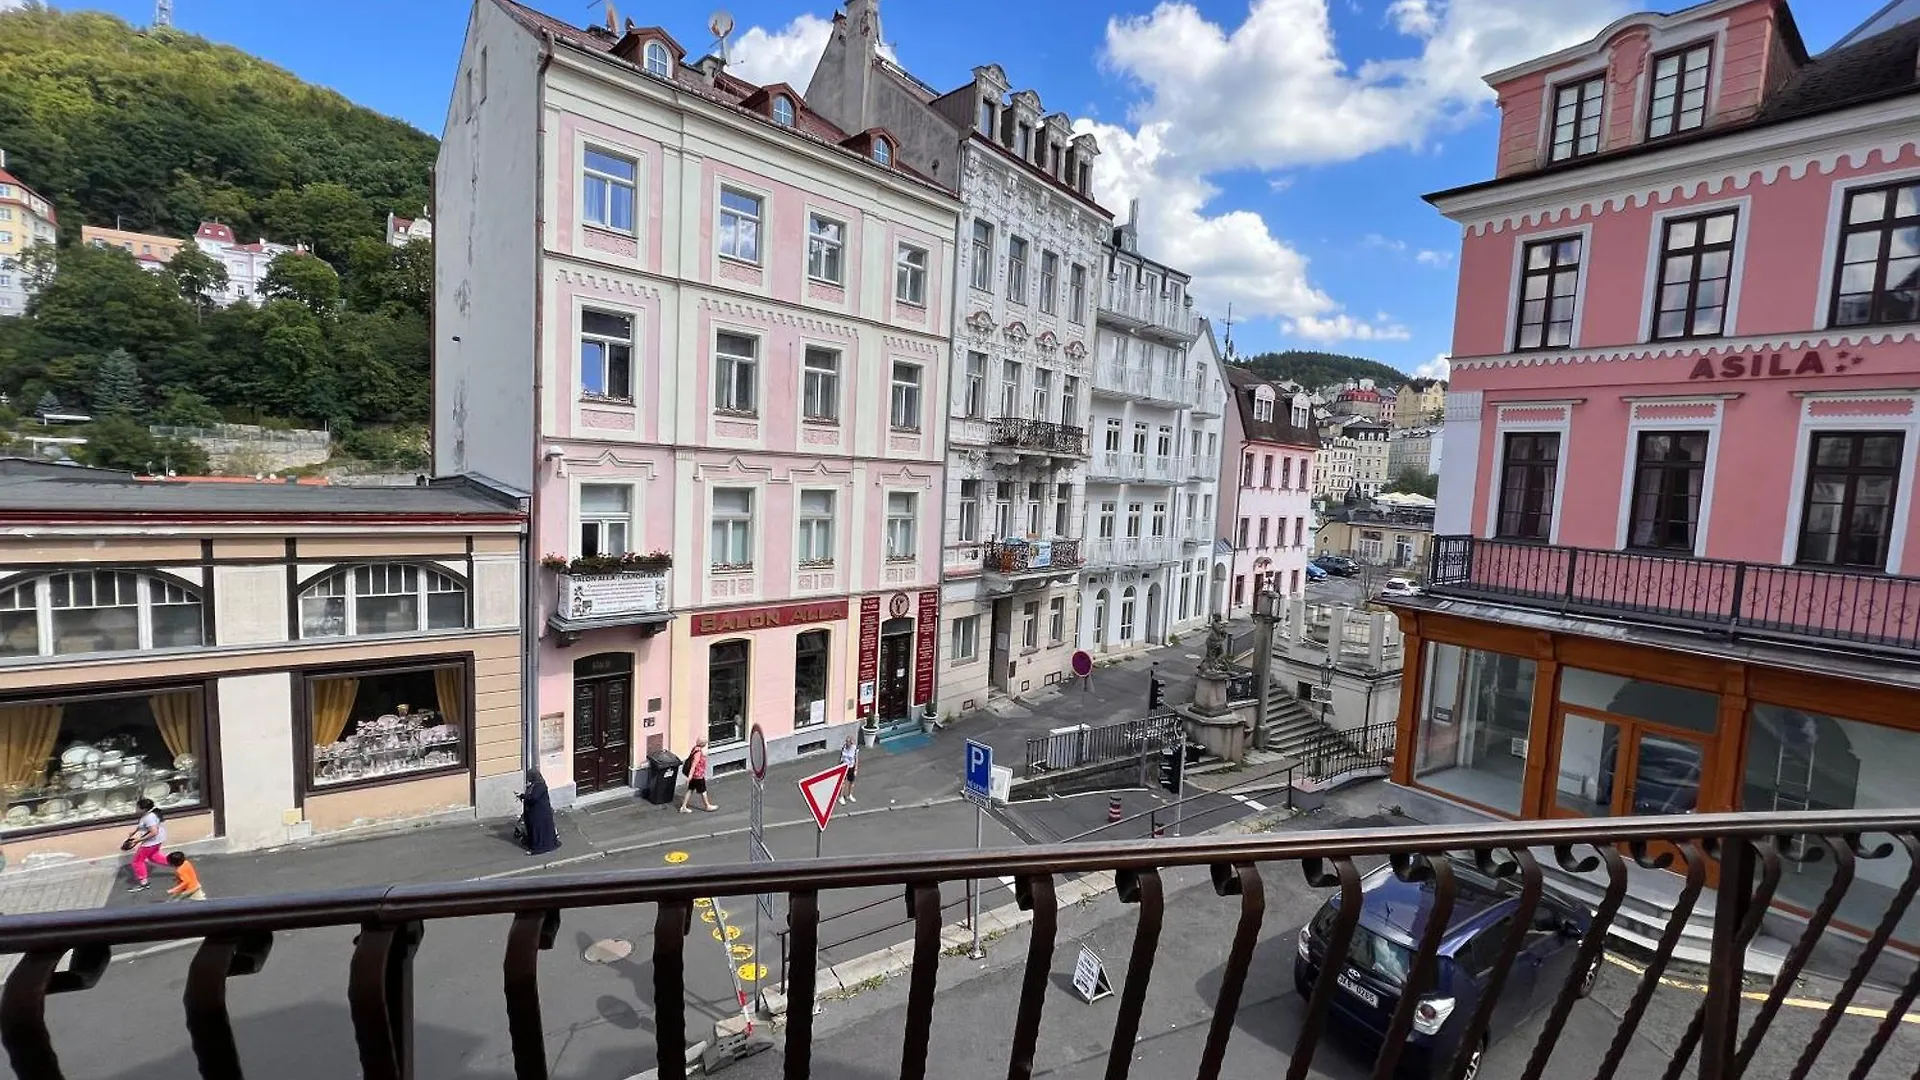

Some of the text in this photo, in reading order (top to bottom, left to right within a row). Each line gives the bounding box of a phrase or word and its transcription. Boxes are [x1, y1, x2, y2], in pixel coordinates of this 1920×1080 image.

[1689, 351, 1824, 380] ASILA
[700, 609, 780, 632] SALON
[790, 604, 843, 622] ALLA
[971, 746, 984, 773] P
